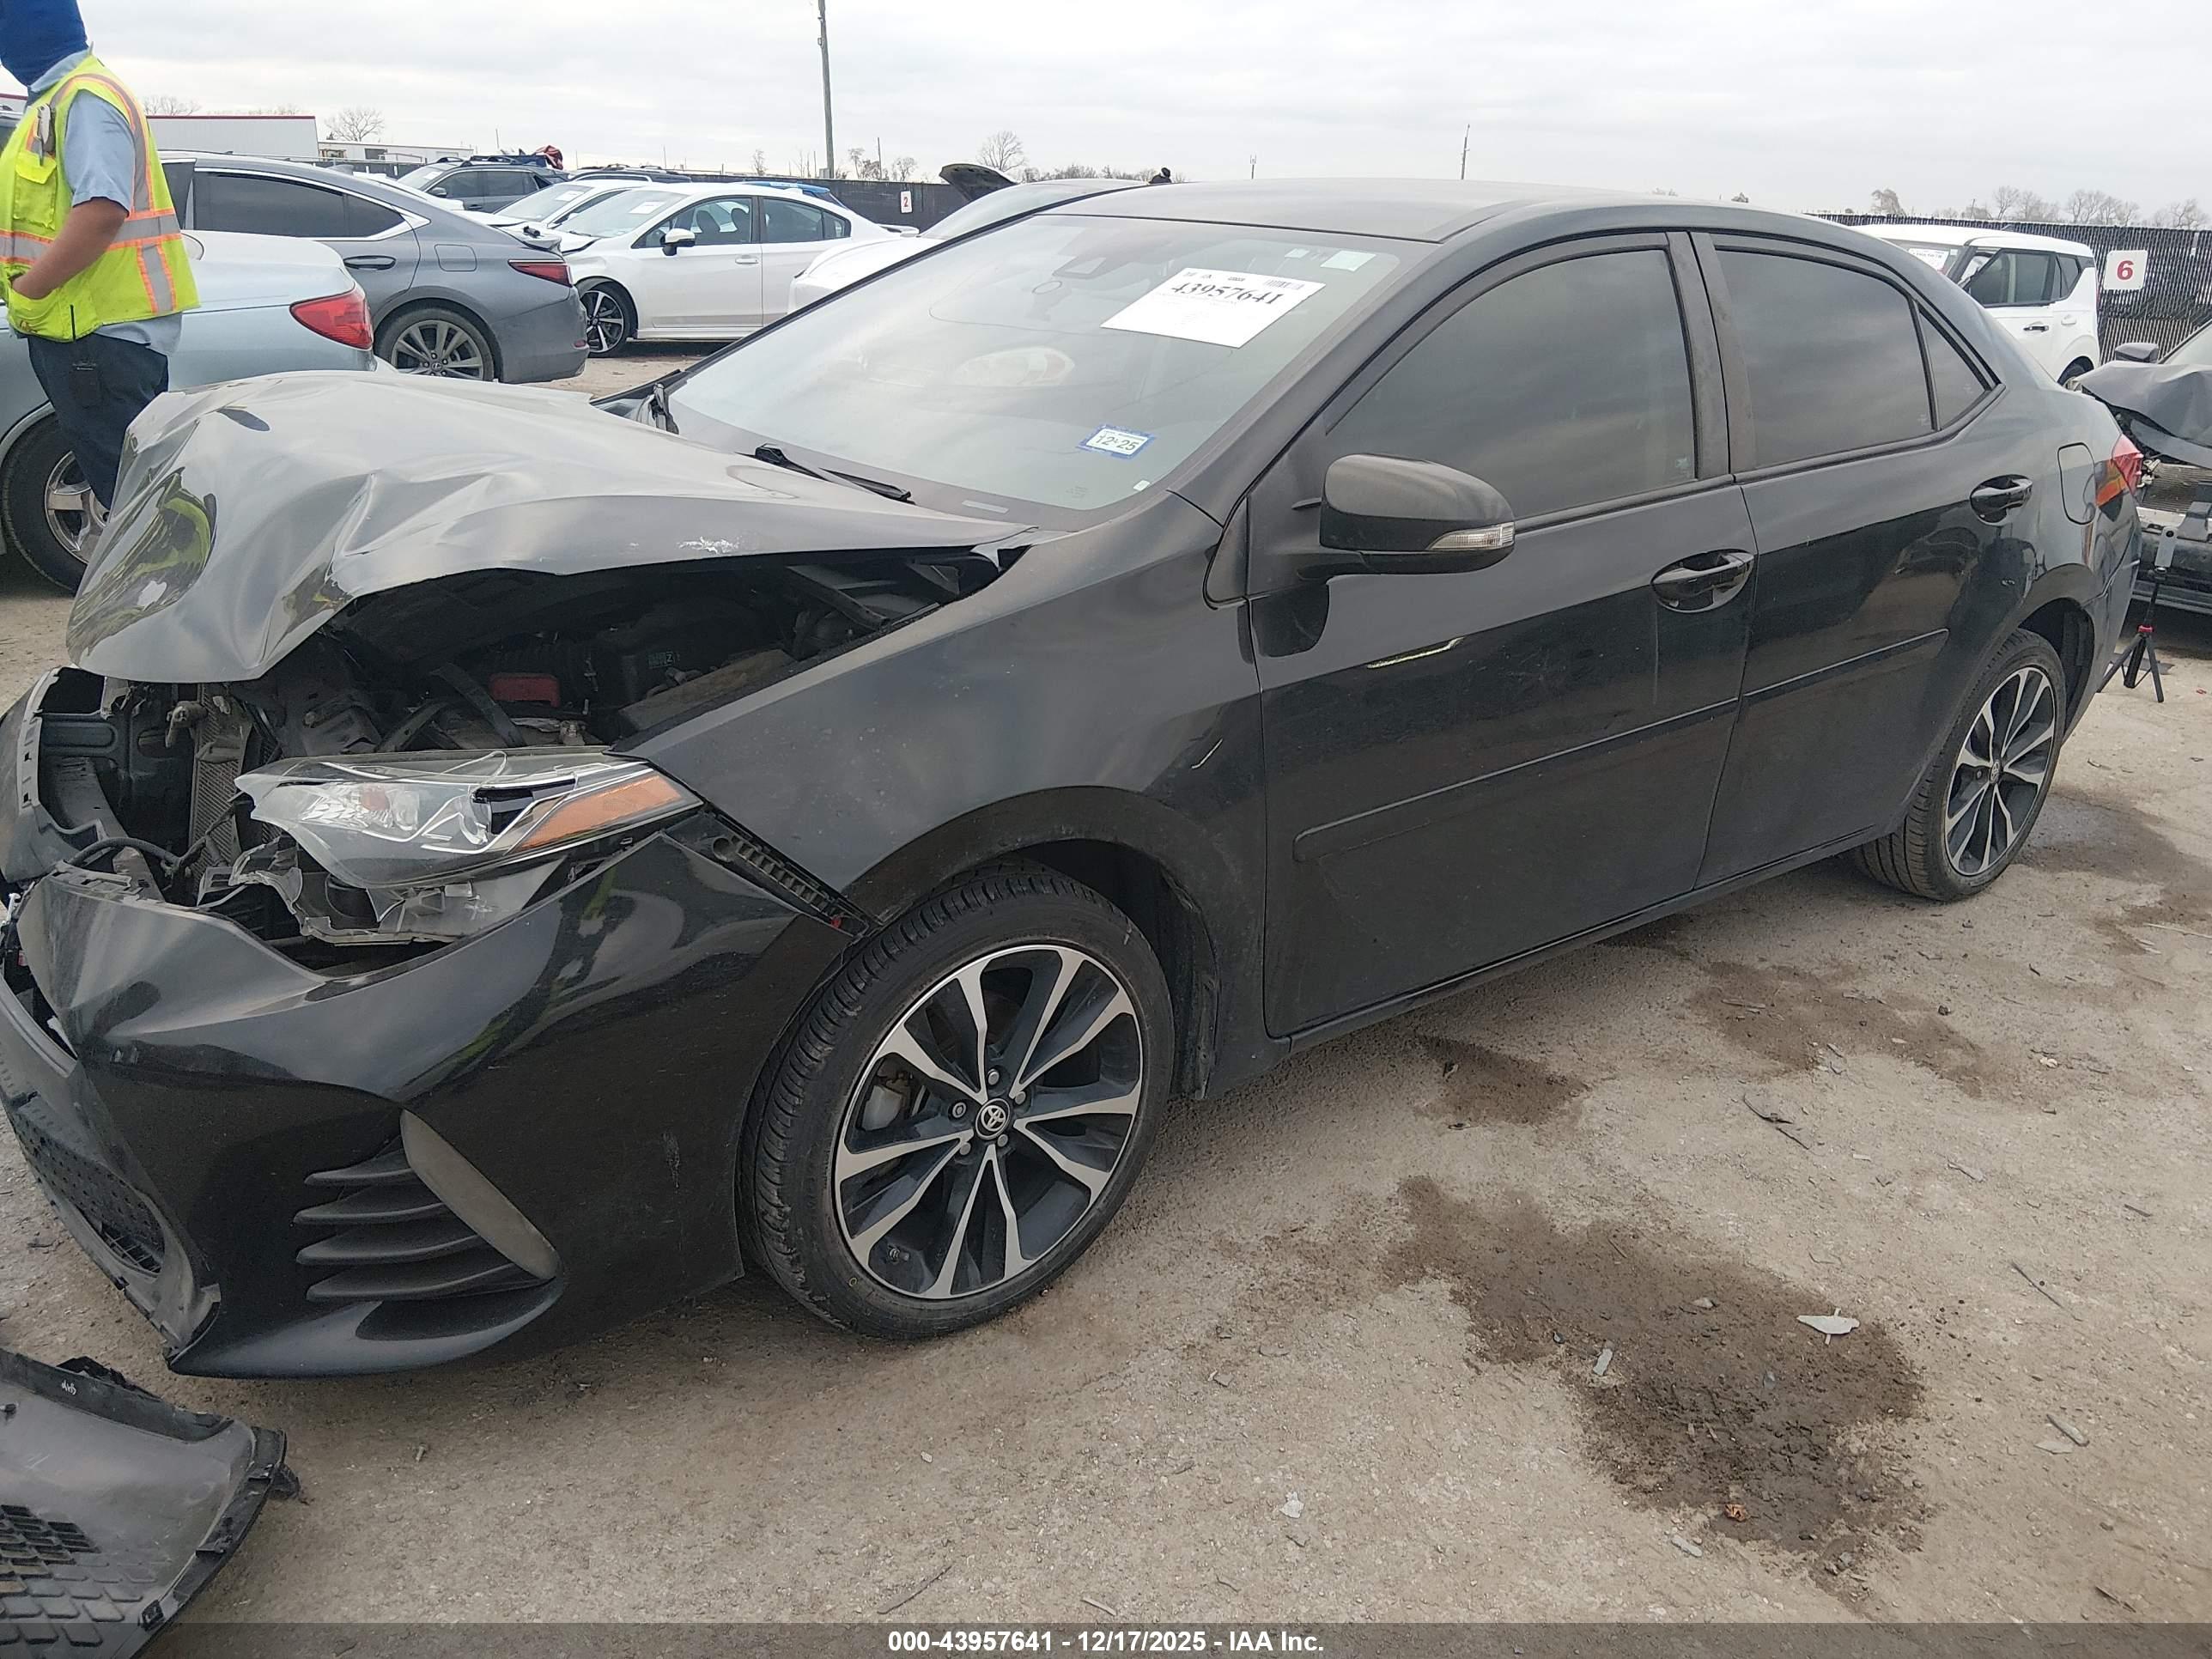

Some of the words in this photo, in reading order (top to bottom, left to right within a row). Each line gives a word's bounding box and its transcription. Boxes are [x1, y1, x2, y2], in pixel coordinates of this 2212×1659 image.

[903, 197, 908, 207] 2
[2117, 260, 2134, 280] 6
[1171, 283, 1284, 304] 43957641
